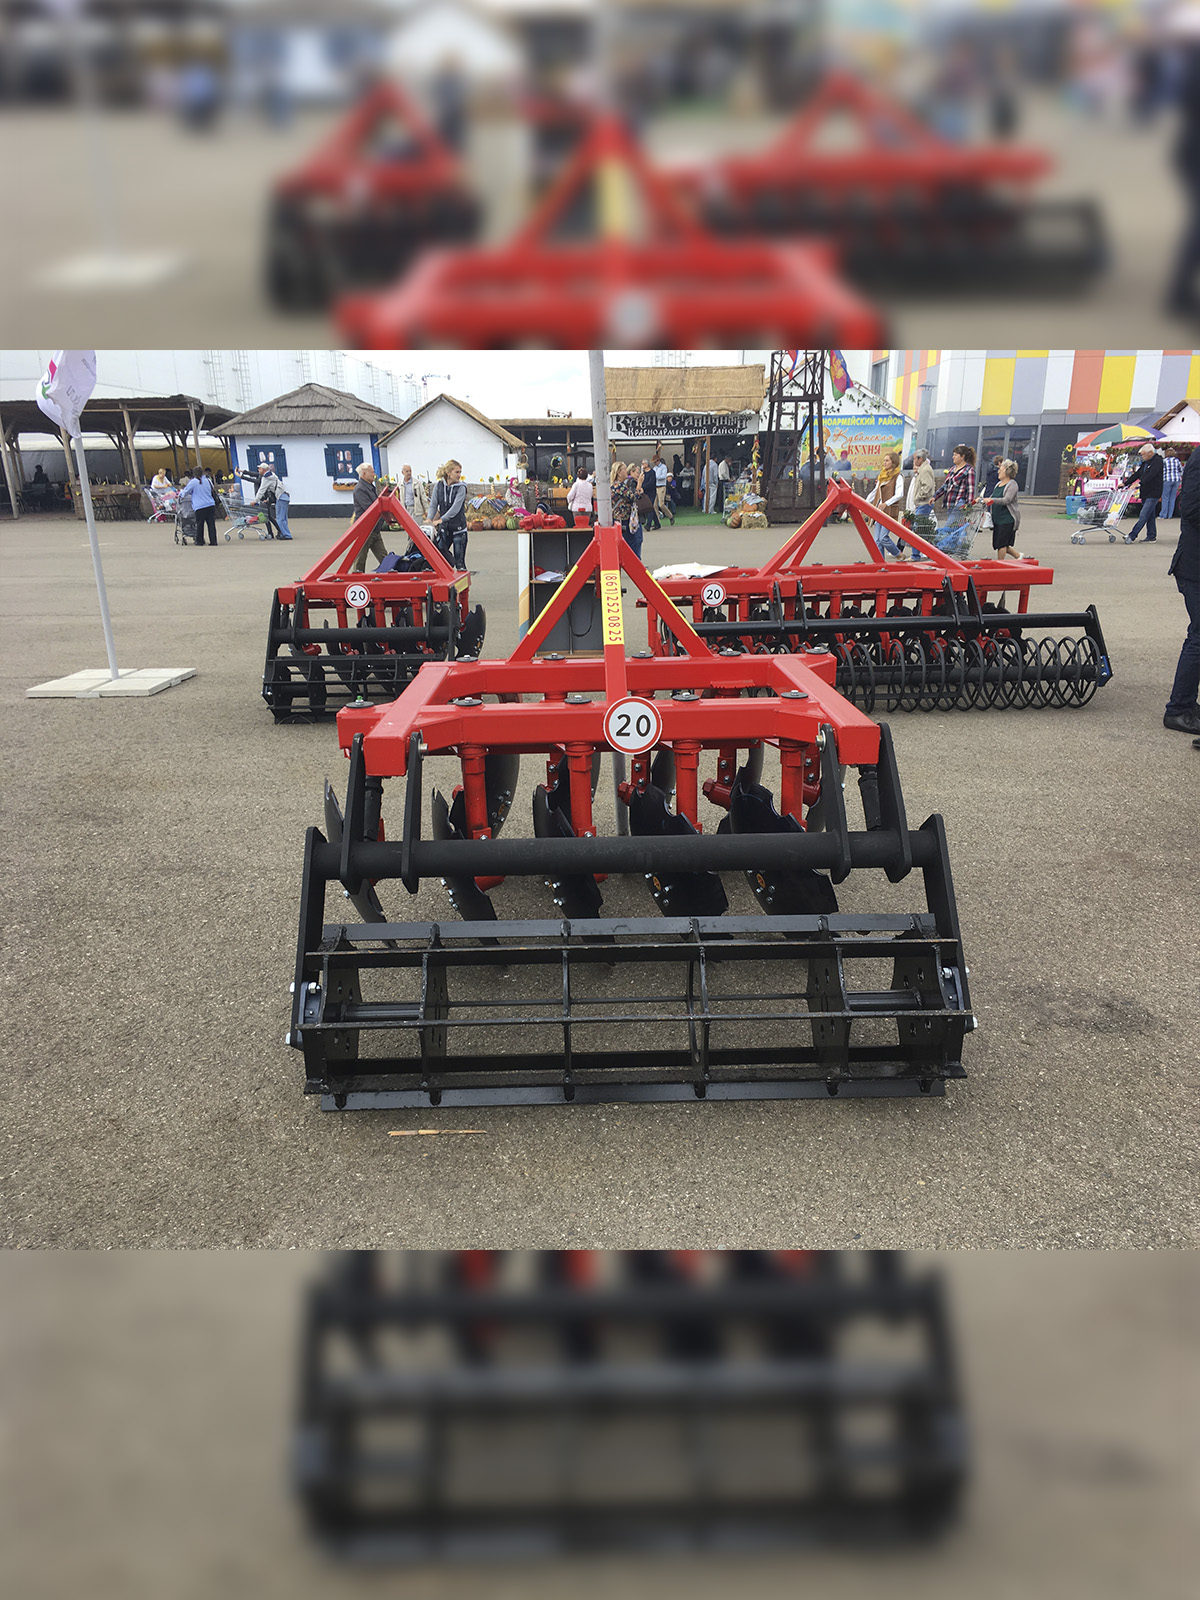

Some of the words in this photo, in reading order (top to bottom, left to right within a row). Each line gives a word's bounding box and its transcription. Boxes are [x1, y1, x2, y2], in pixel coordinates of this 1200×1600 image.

[804, 416, 875, 426] АНОАРМЕЙСКИЙ
[878, 416, 903, 426] РАЙОН
[832, 427, 895, 449] Кубанская
[847, 444, 881, 455] КУХНЯ
[350, 590, 366, 601] 20
[706, 589, 721, 600] 20
[608, 616, 621, 628] 08
[609, 630, 622, 642] 25
[615, 713, 651, 737] 20
